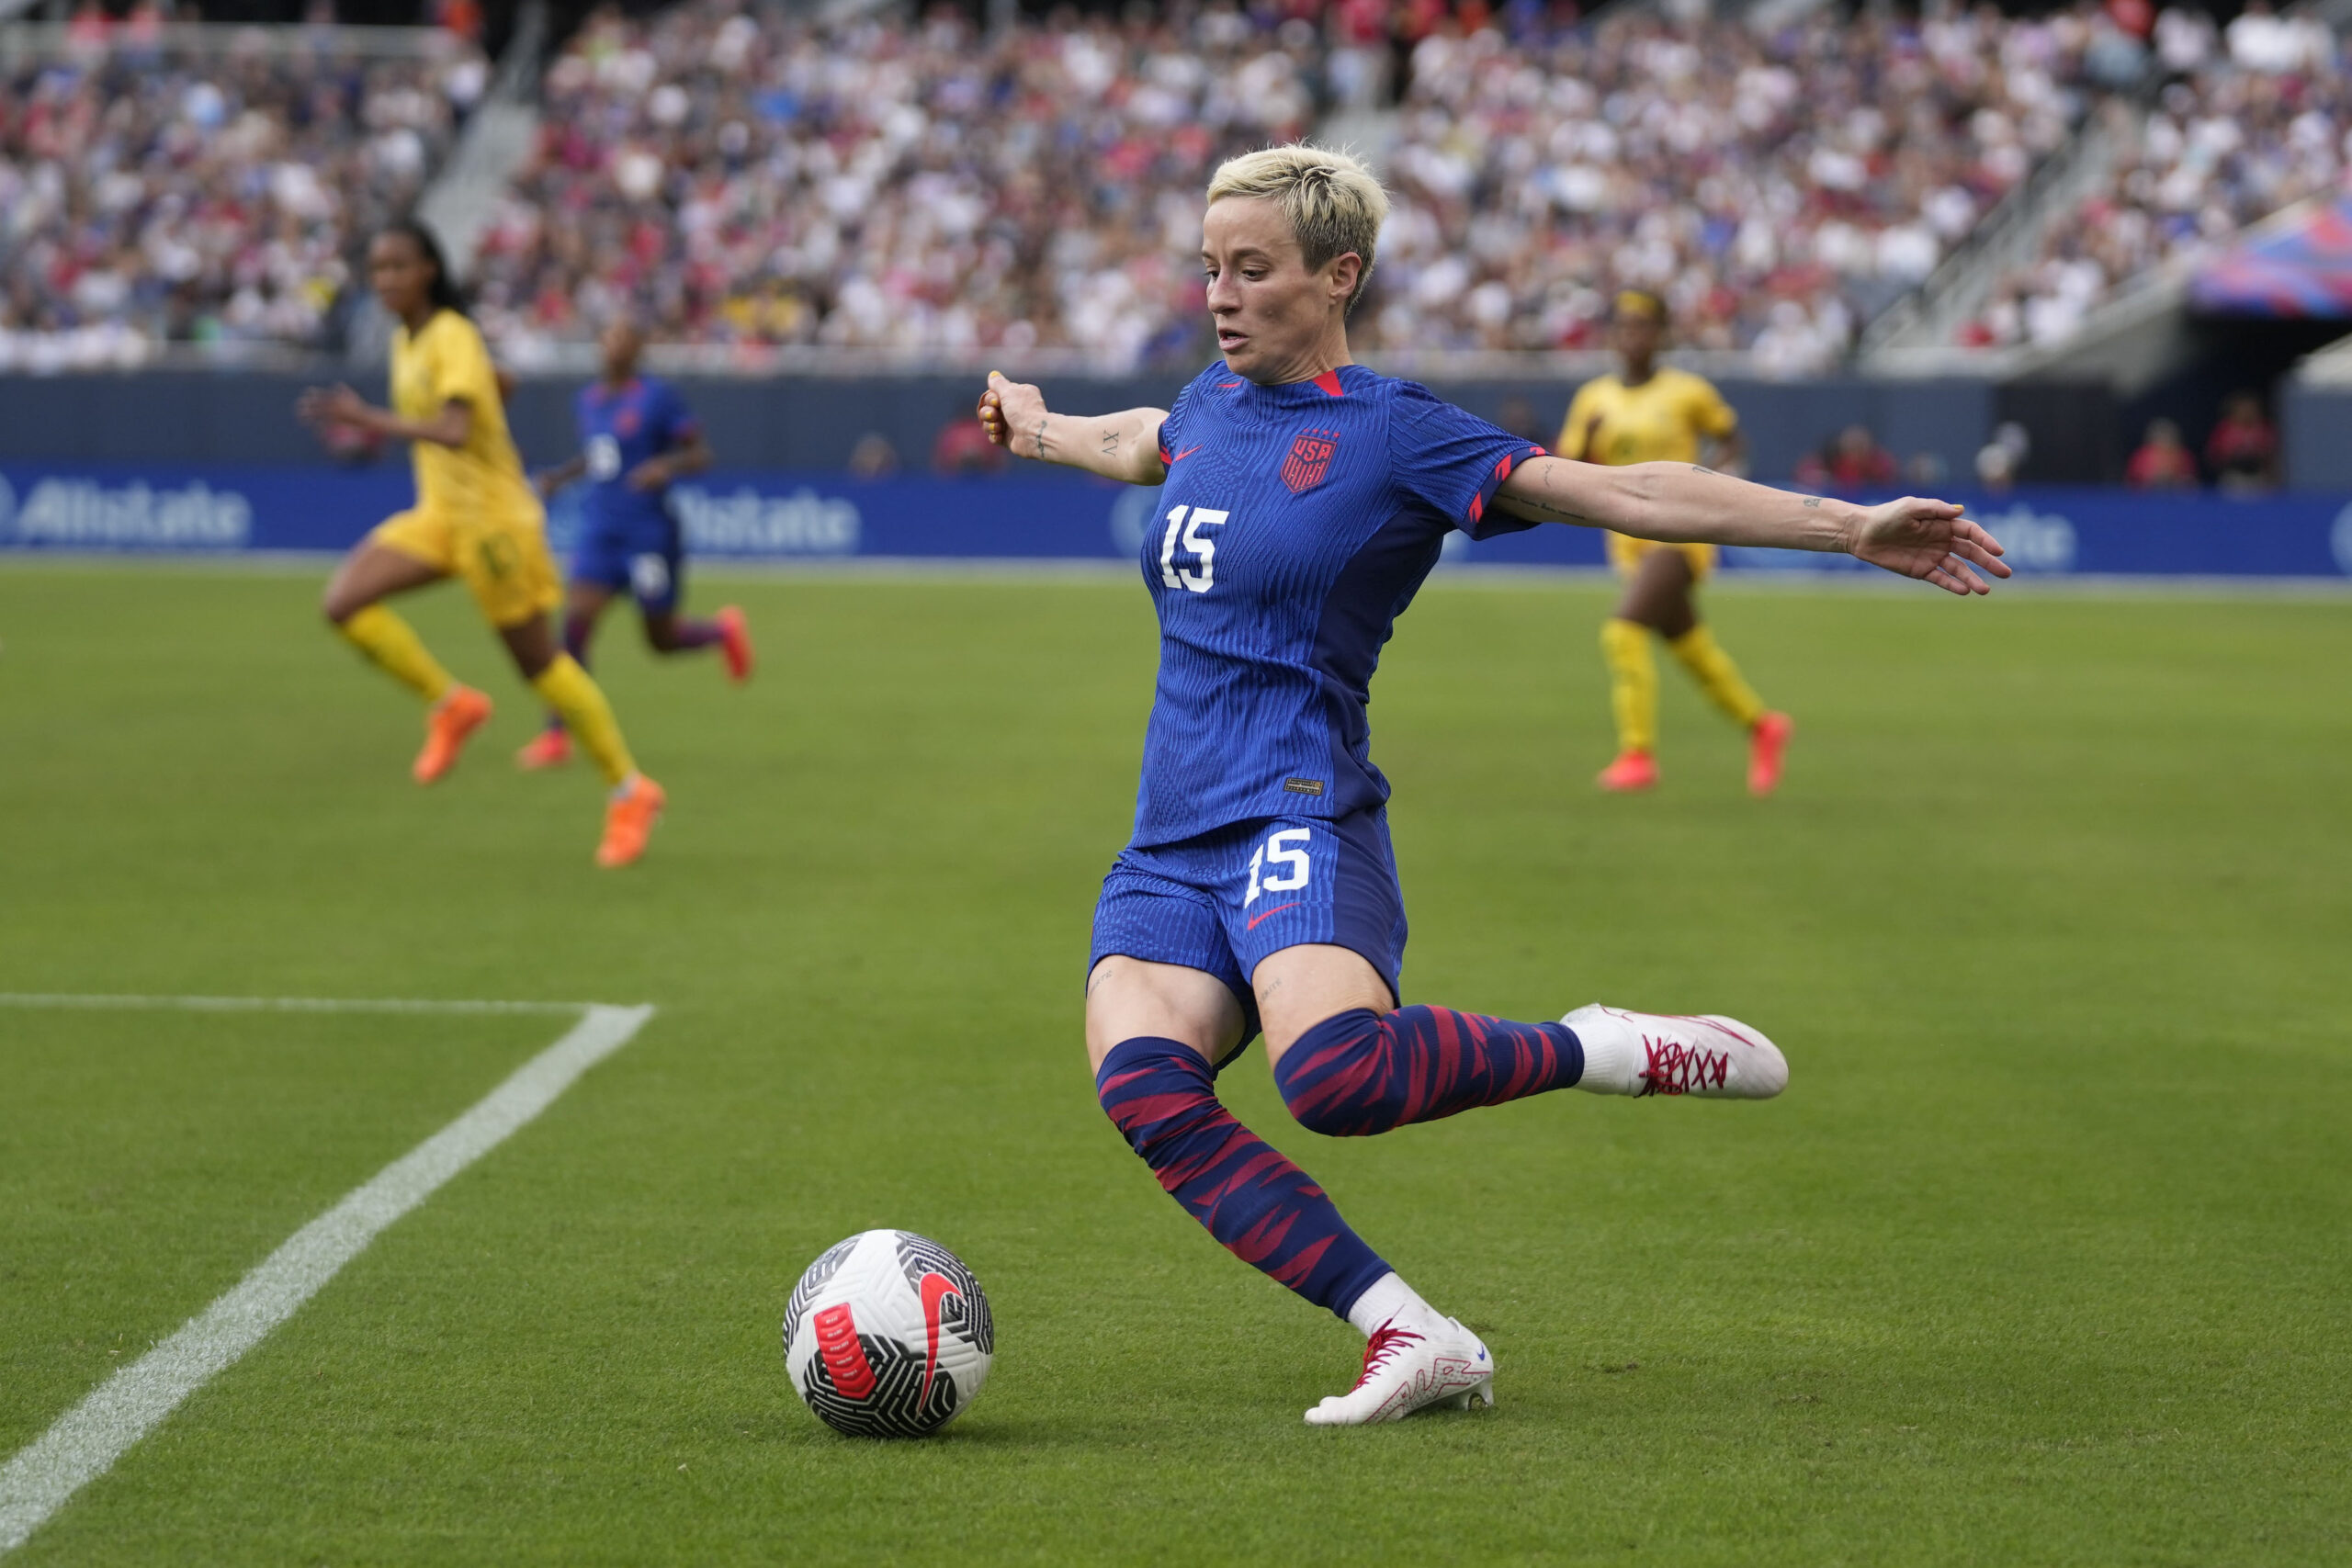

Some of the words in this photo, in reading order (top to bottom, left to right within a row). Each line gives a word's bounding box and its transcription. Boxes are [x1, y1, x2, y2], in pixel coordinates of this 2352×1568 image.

[1102, 428, 1120, 457] XV
[1294, 438, 1332, 462] USA
[1160, 504, 1230, 594] 15
[1244, 827, 1311, 909] 15
